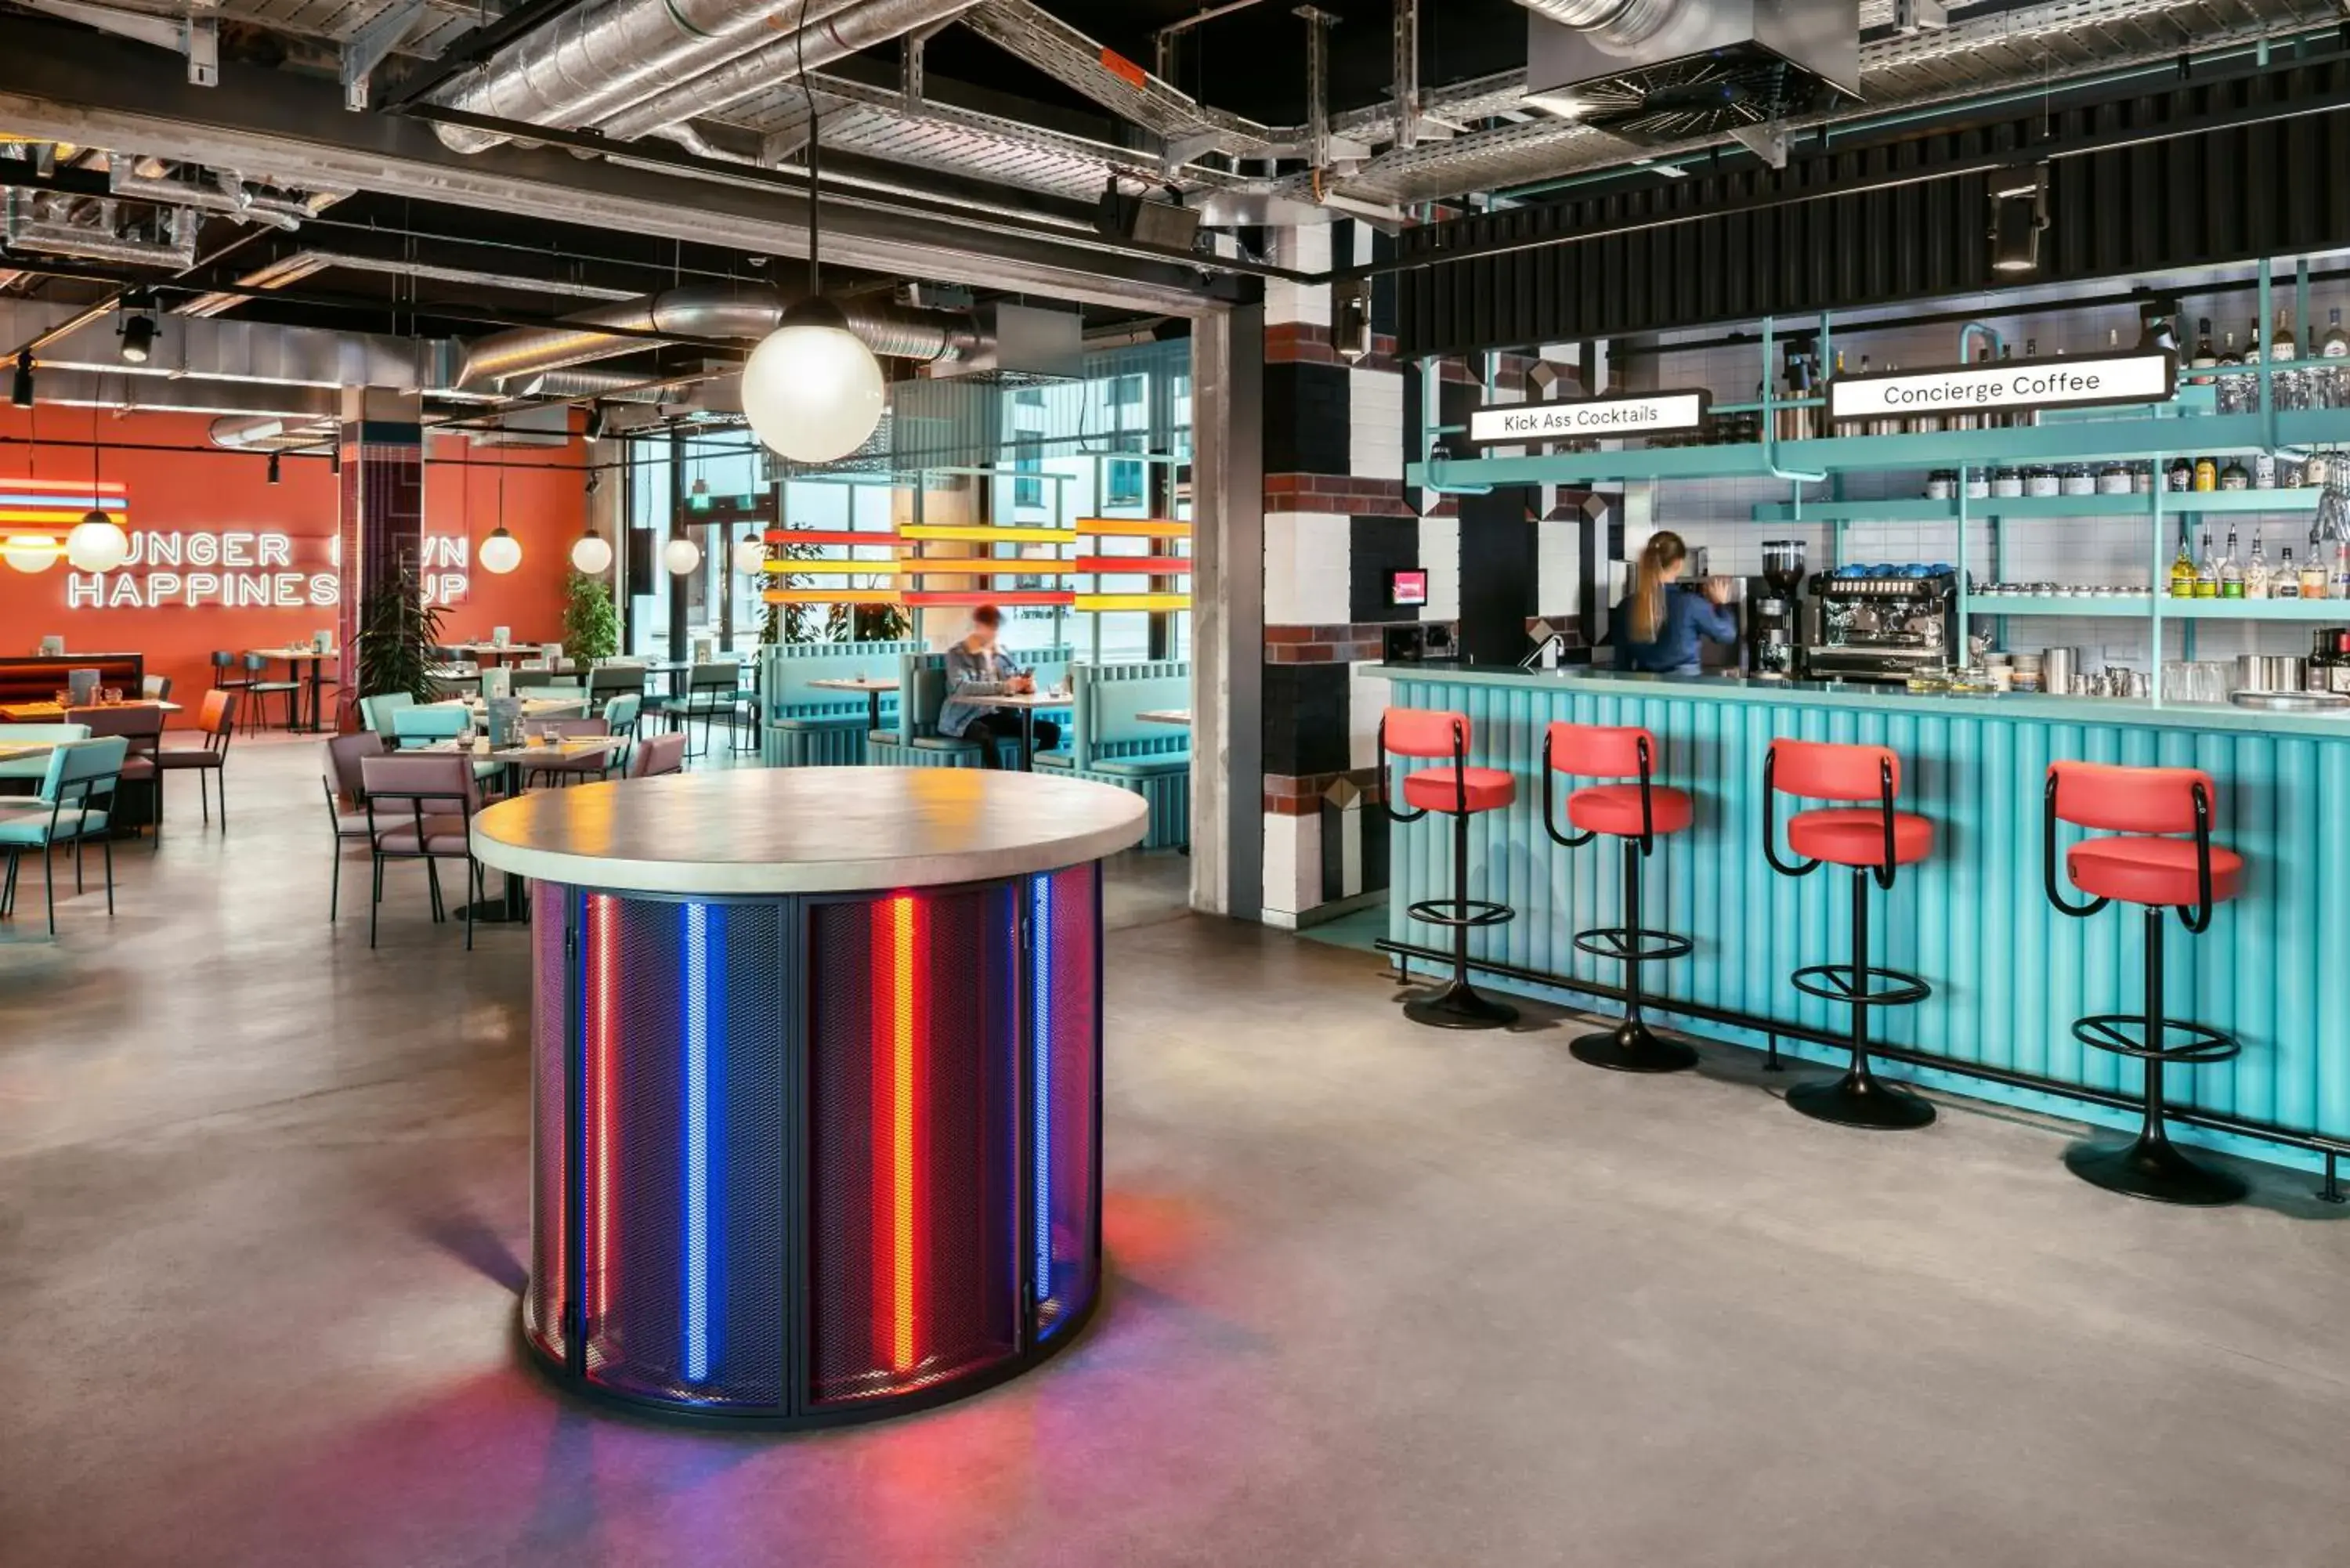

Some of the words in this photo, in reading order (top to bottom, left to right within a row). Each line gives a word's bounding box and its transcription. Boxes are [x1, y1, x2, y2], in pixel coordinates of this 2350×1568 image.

[1884, 381, 2003, 404] Concierge
[2012, 372, 2100, 395] Coffee
[1504, 414, 1538, 432] Kick
[1543, 413, 1571, 428] Ass
[1576, 405, 1658, 426] Cocktails
[69, 531, 290, 566] UNGER
[67, 572, 340, 608] HAPPINES
